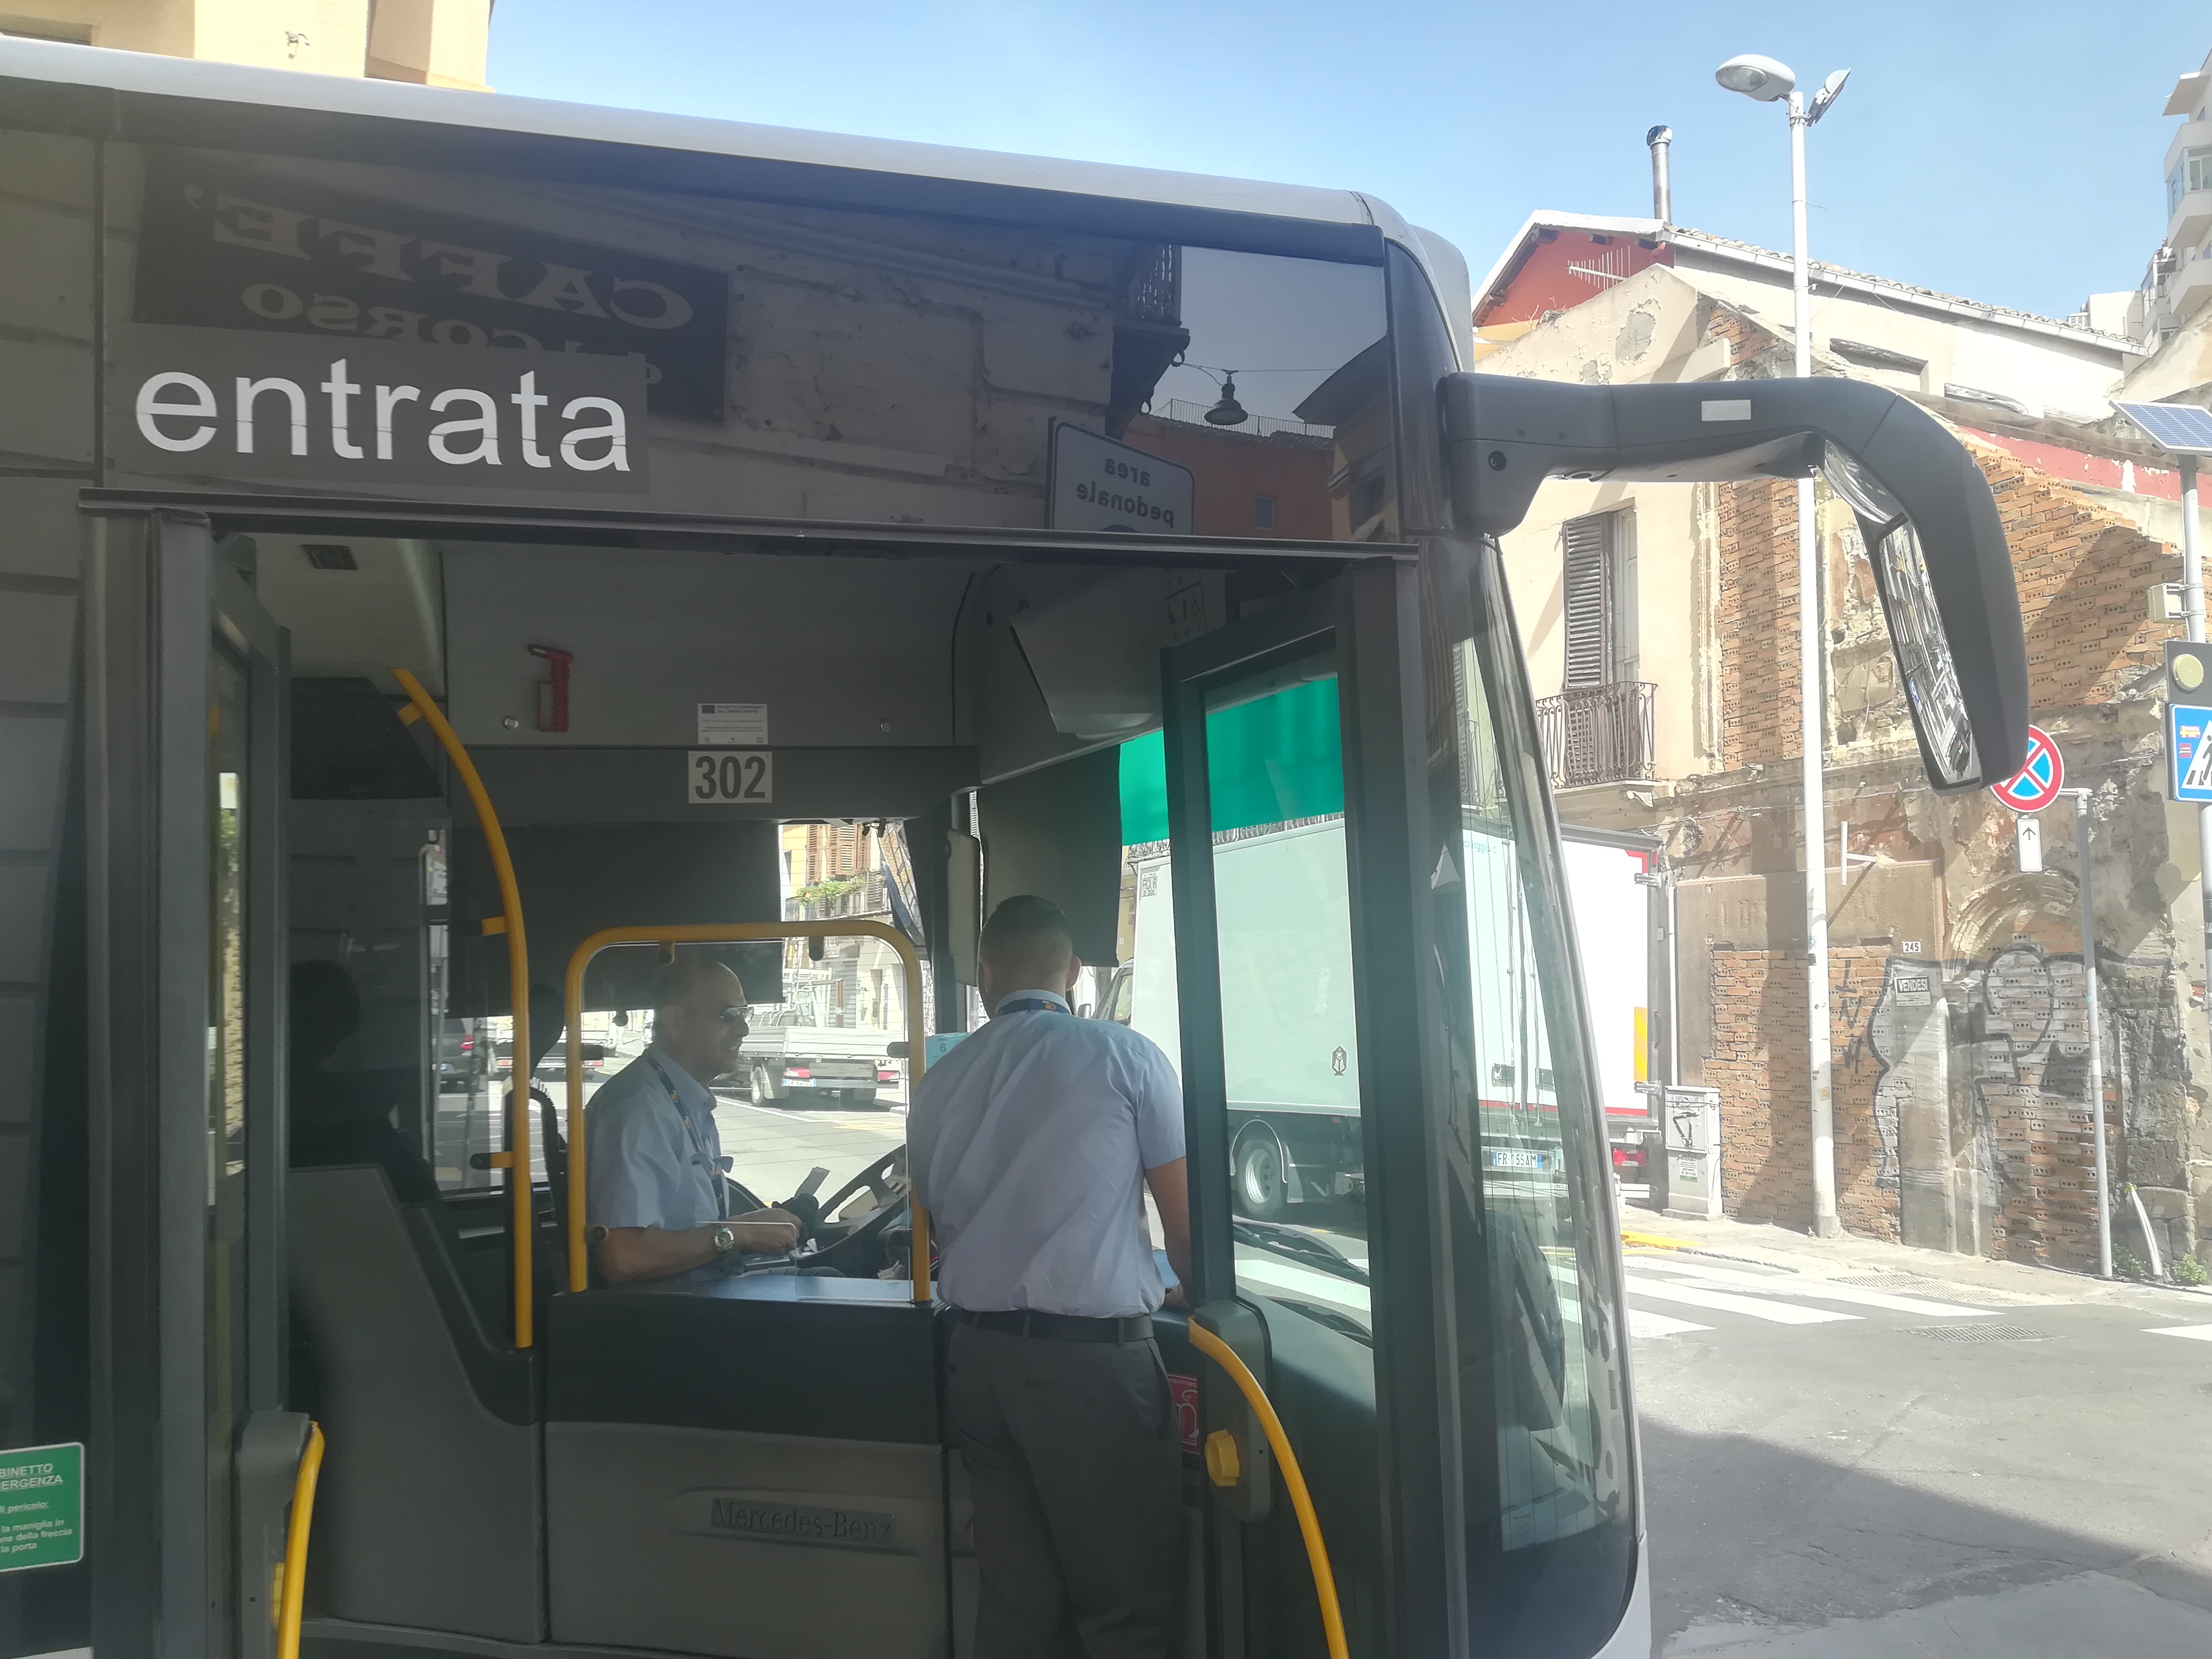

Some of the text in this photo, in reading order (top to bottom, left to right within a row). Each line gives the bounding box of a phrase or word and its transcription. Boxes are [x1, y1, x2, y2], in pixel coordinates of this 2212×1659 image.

[135, 357, 631, 472] entrata
[695, 755, 766, 799] 302
[1905, 943, 1919, 952] 245
[1898, 978, 1928, 992] VENDESI
[0, 1474, 63, 1490] ERGENZA
[713, 1497, 891, 1540] Mercedes-Benz
